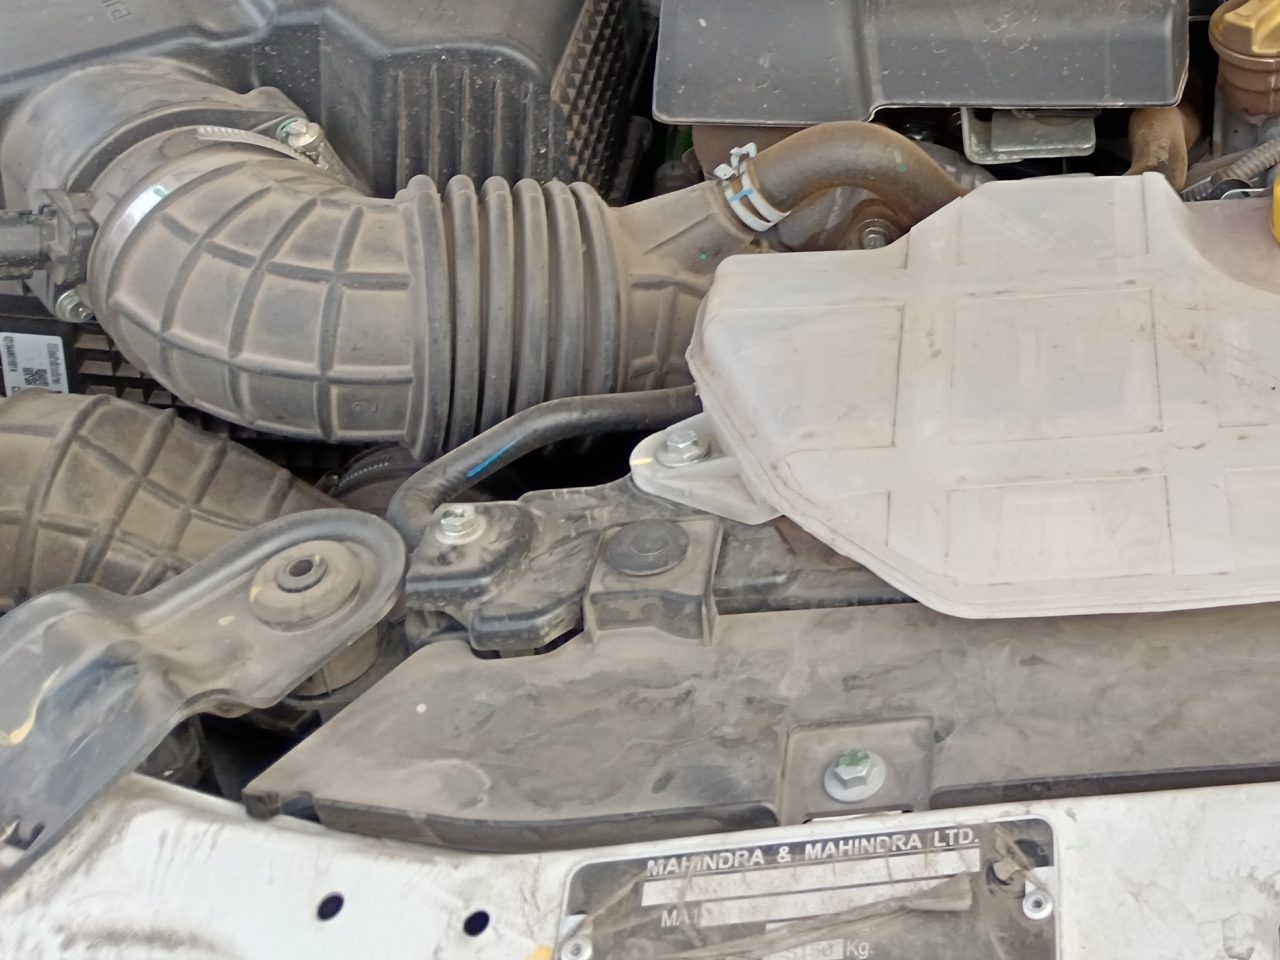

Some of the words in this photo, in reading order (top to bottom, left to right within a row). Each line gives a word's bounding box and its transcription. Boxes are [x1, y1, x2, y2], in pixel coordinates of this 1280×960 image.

[646, 848, 765, 876] MAHINDRA
[776, 845, 792, 863] &
[804, 832, 922, 860] MAHINDRA
[933, 827, 980, 848] LTD.
